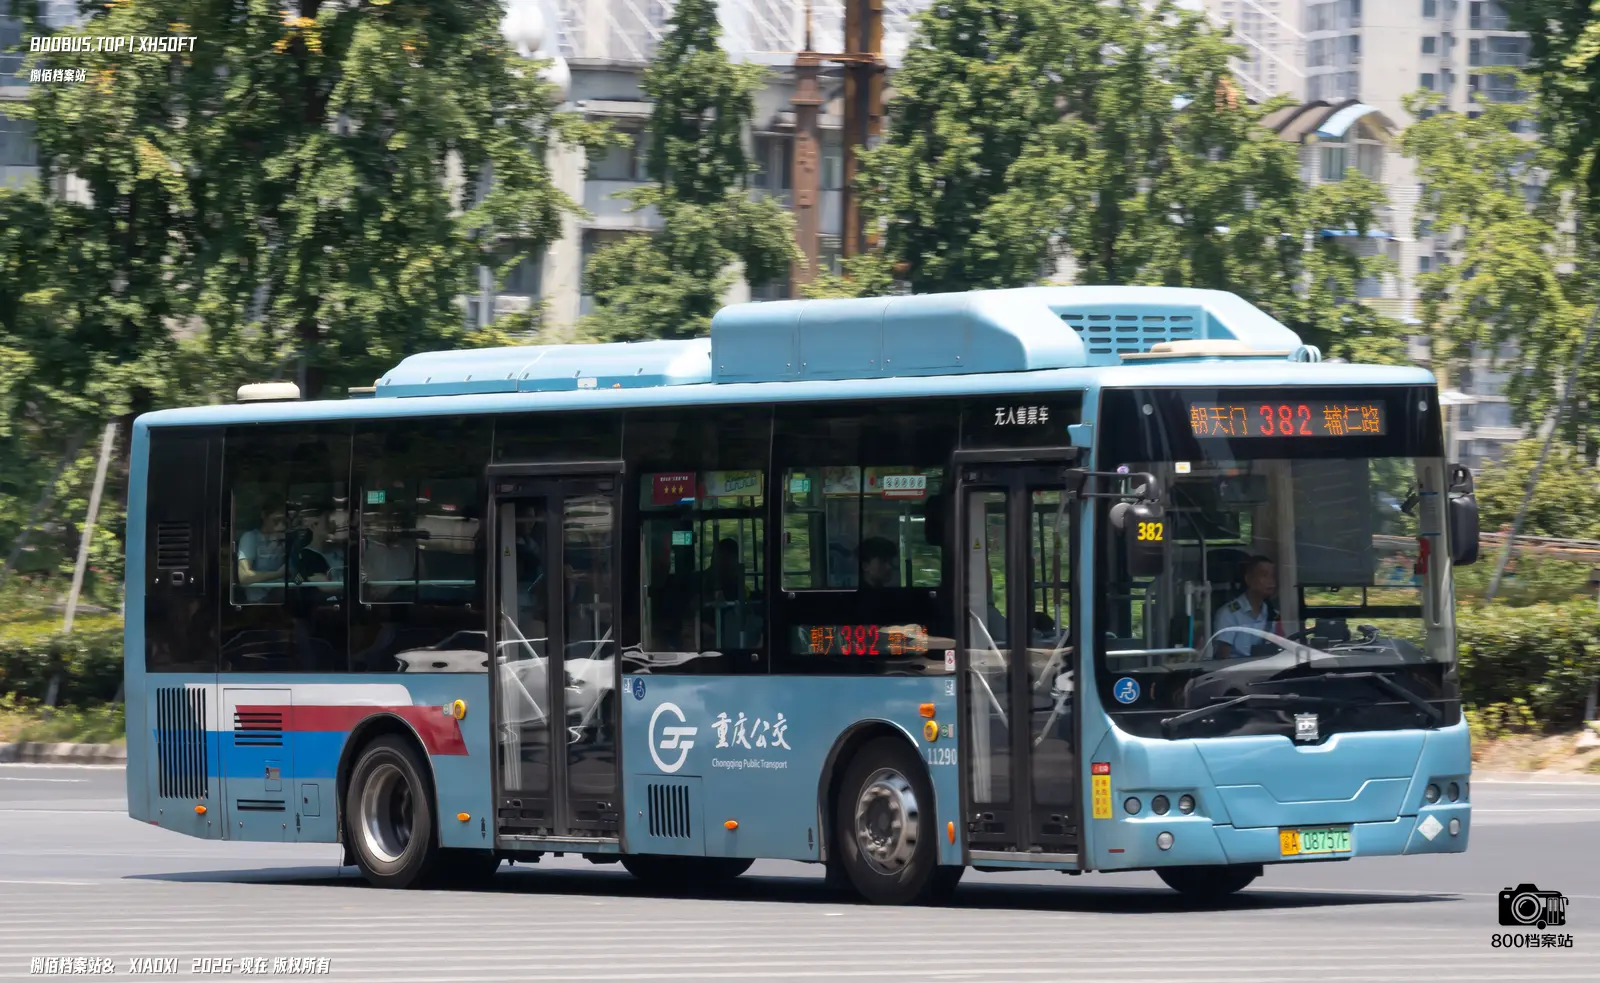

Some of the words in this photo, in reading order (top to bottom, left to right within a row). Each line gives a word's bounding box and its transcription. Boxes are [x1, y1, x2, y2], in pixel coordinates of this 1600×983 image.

[994, 405, 1049, 425] 无人售票车
[1190, 405, 1248, 436] 朝天门
[1259, 404, 1313, 436] 382
[1323, 404, 1380, 435] 辅仁路
[1137, 521, 1164, 541] 382
[841, 625, 879, 655] 382
[711, 712, 791, 750] 重庆公交
[712, 758, 742, 770] Chongqing
[743, 759, 760, 769] Public
[760, 759, 787, 771] Transport
[927, 748, 957, 765] 11290
